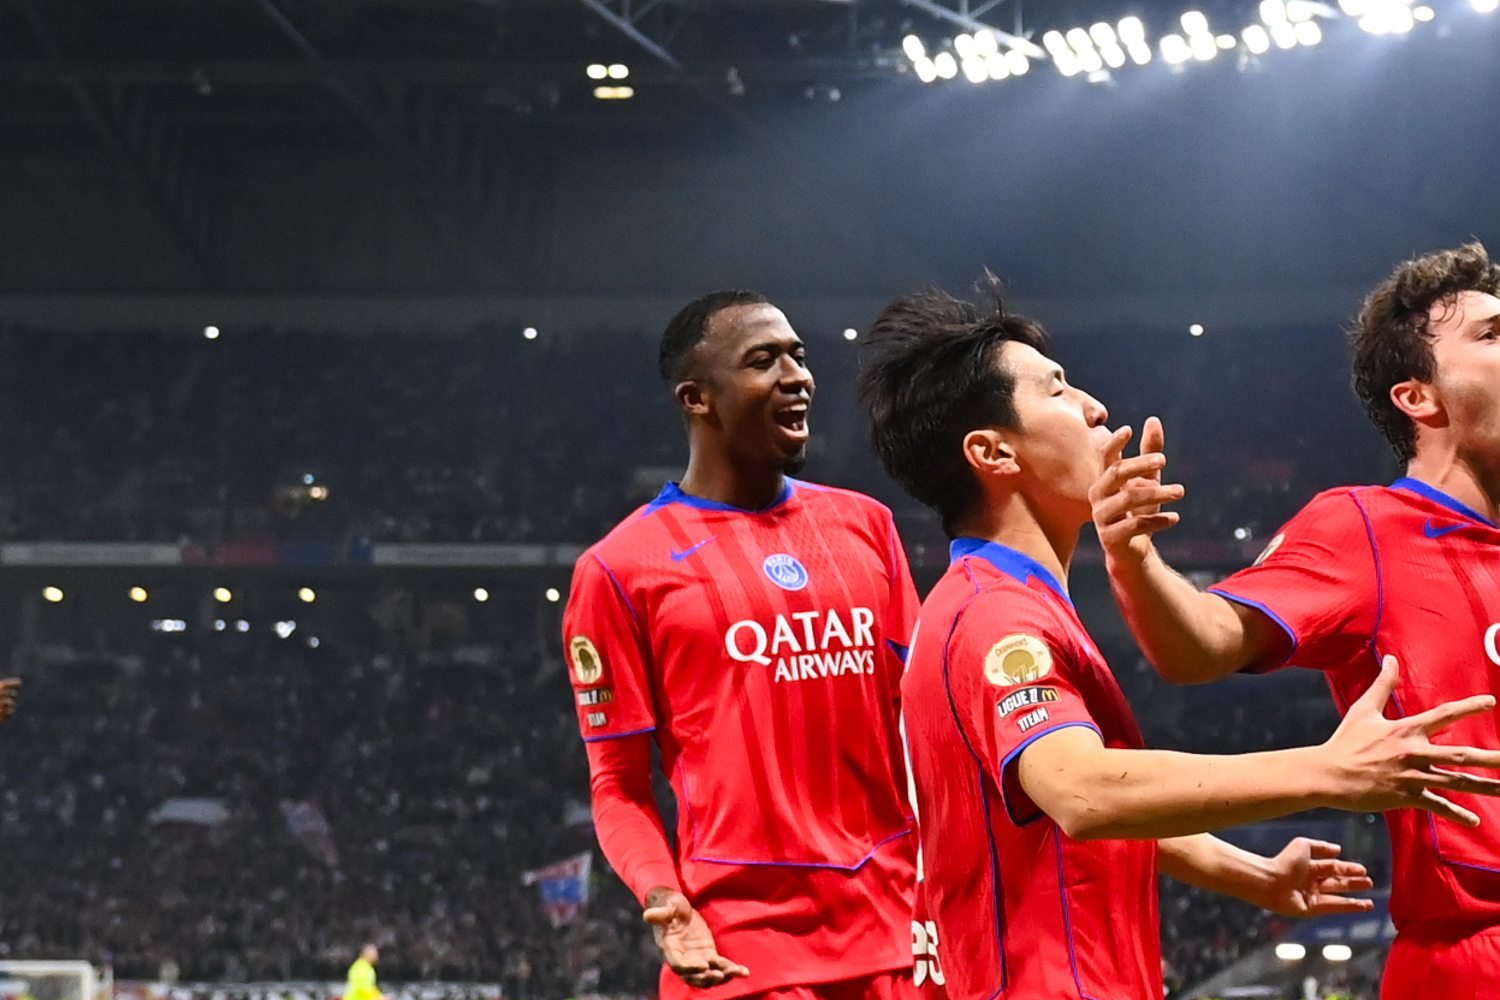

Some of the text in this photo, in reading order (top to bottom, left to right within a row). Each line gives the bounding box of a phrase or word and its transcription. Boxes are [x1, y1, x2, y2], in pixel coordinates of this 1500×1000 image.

[725, 607, 875, 666] QATAR
[774, 649, 875, 683] AIRWAYS
[997, 690, 1030, 719] LIGUE
